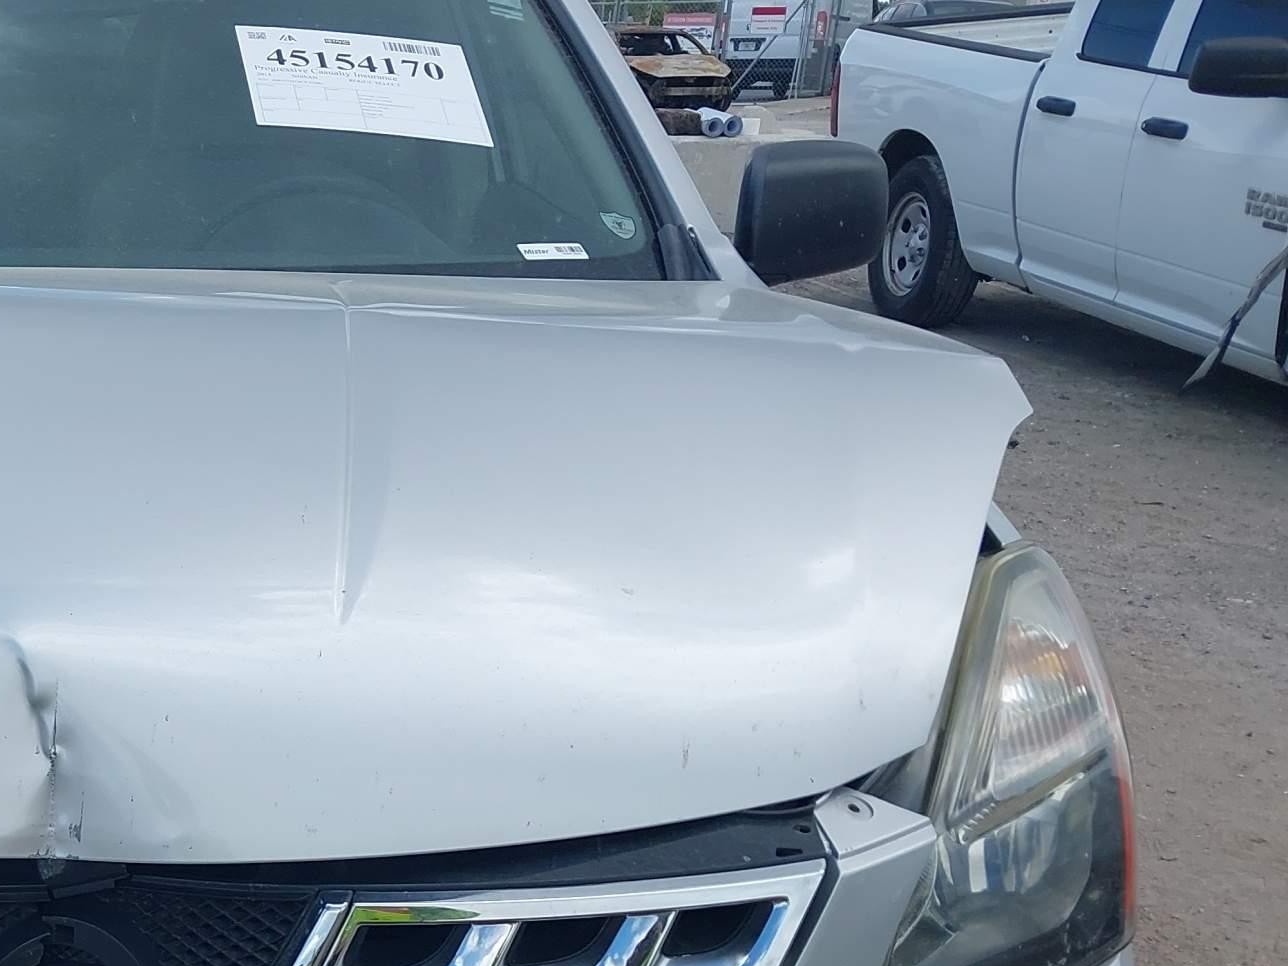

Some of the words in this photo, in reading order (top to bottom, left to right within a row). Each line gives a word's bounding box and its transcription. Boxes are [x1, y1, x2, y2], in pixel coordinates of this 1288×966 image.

[254, 65, 308, 74] Progressive
[310, 68, 350, 77] Casualty
[353, 72, 398, 81] Insurance
[266, 47, 444, 81] 45154170
